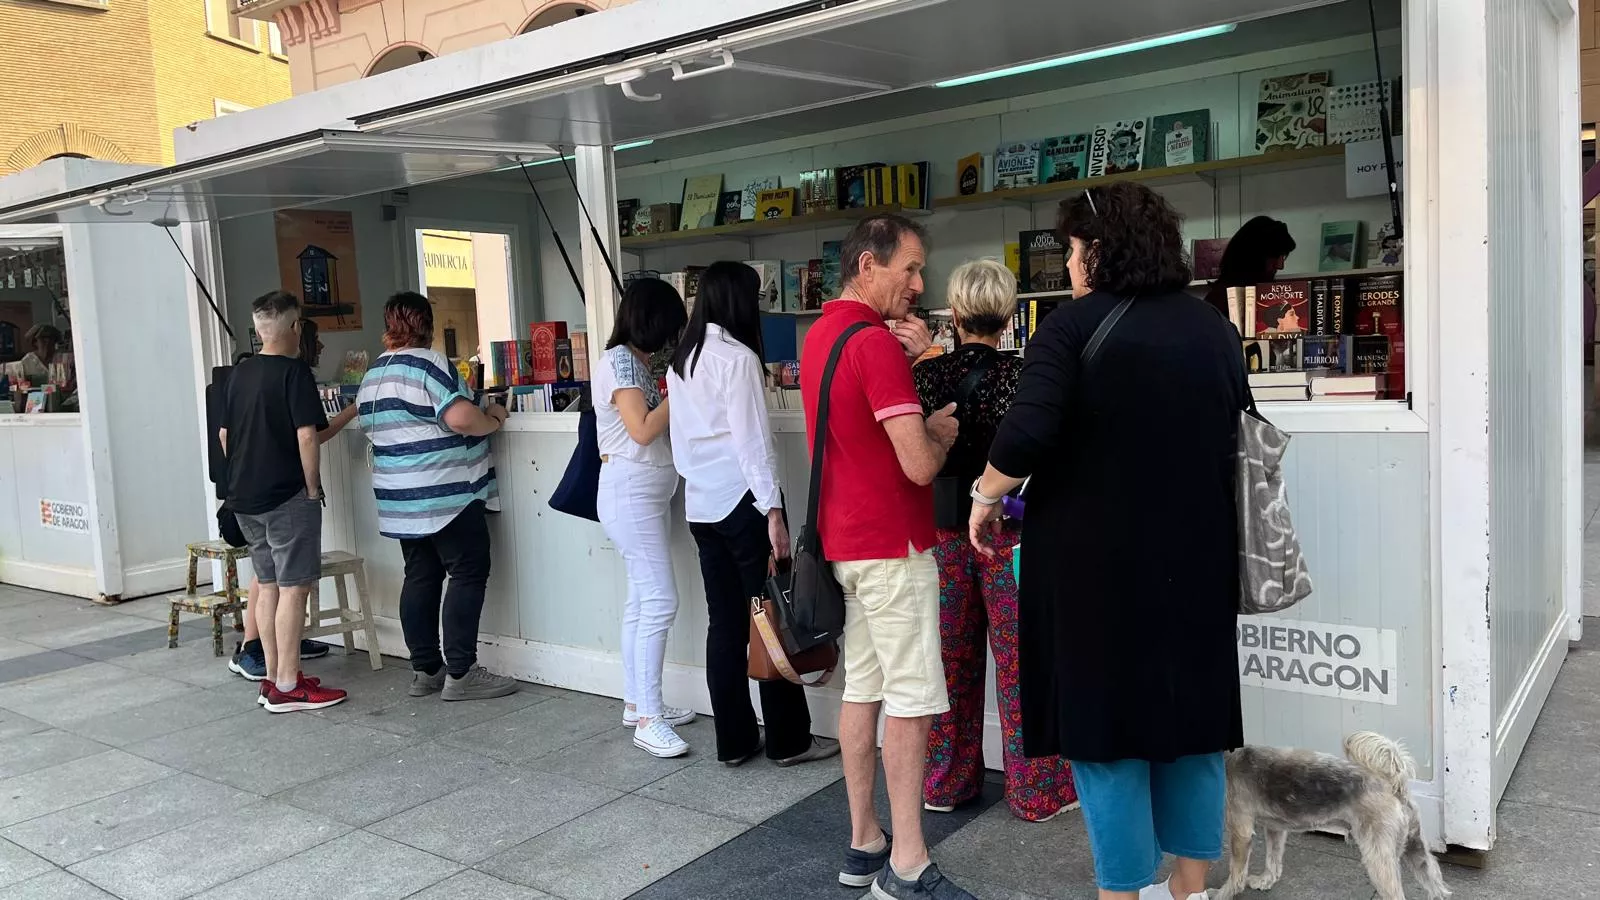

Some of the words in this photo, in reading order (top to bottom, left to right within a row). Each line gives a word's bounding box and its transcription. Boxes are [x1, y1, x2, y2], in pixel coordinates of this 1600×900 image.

[1264, 87, 1320, 101] Animalium
[998, 155, 1035, 169] AVIONES
[1356, 164, 1378, 173] HOY
[1260, 291, 1304, 301] MONFORTE
[1271, 284, 1292, 293] REYES
[1316, 293, 1324, 326] MALDITA
[1334, 294, 1342, 318] ROMA
[1333, 318, 1341, 334] SOY
[1303, 355, 1339, 365] PELIRROJA
[52, 502, 83, 517] GOBIERNO
[53, 514, 61, 526] DE
[62, 516, 89, 531] ARAGON
[1236, 623, 1361, 660] BIERNO
[1242, 653, 1389, 695] ARAGON
